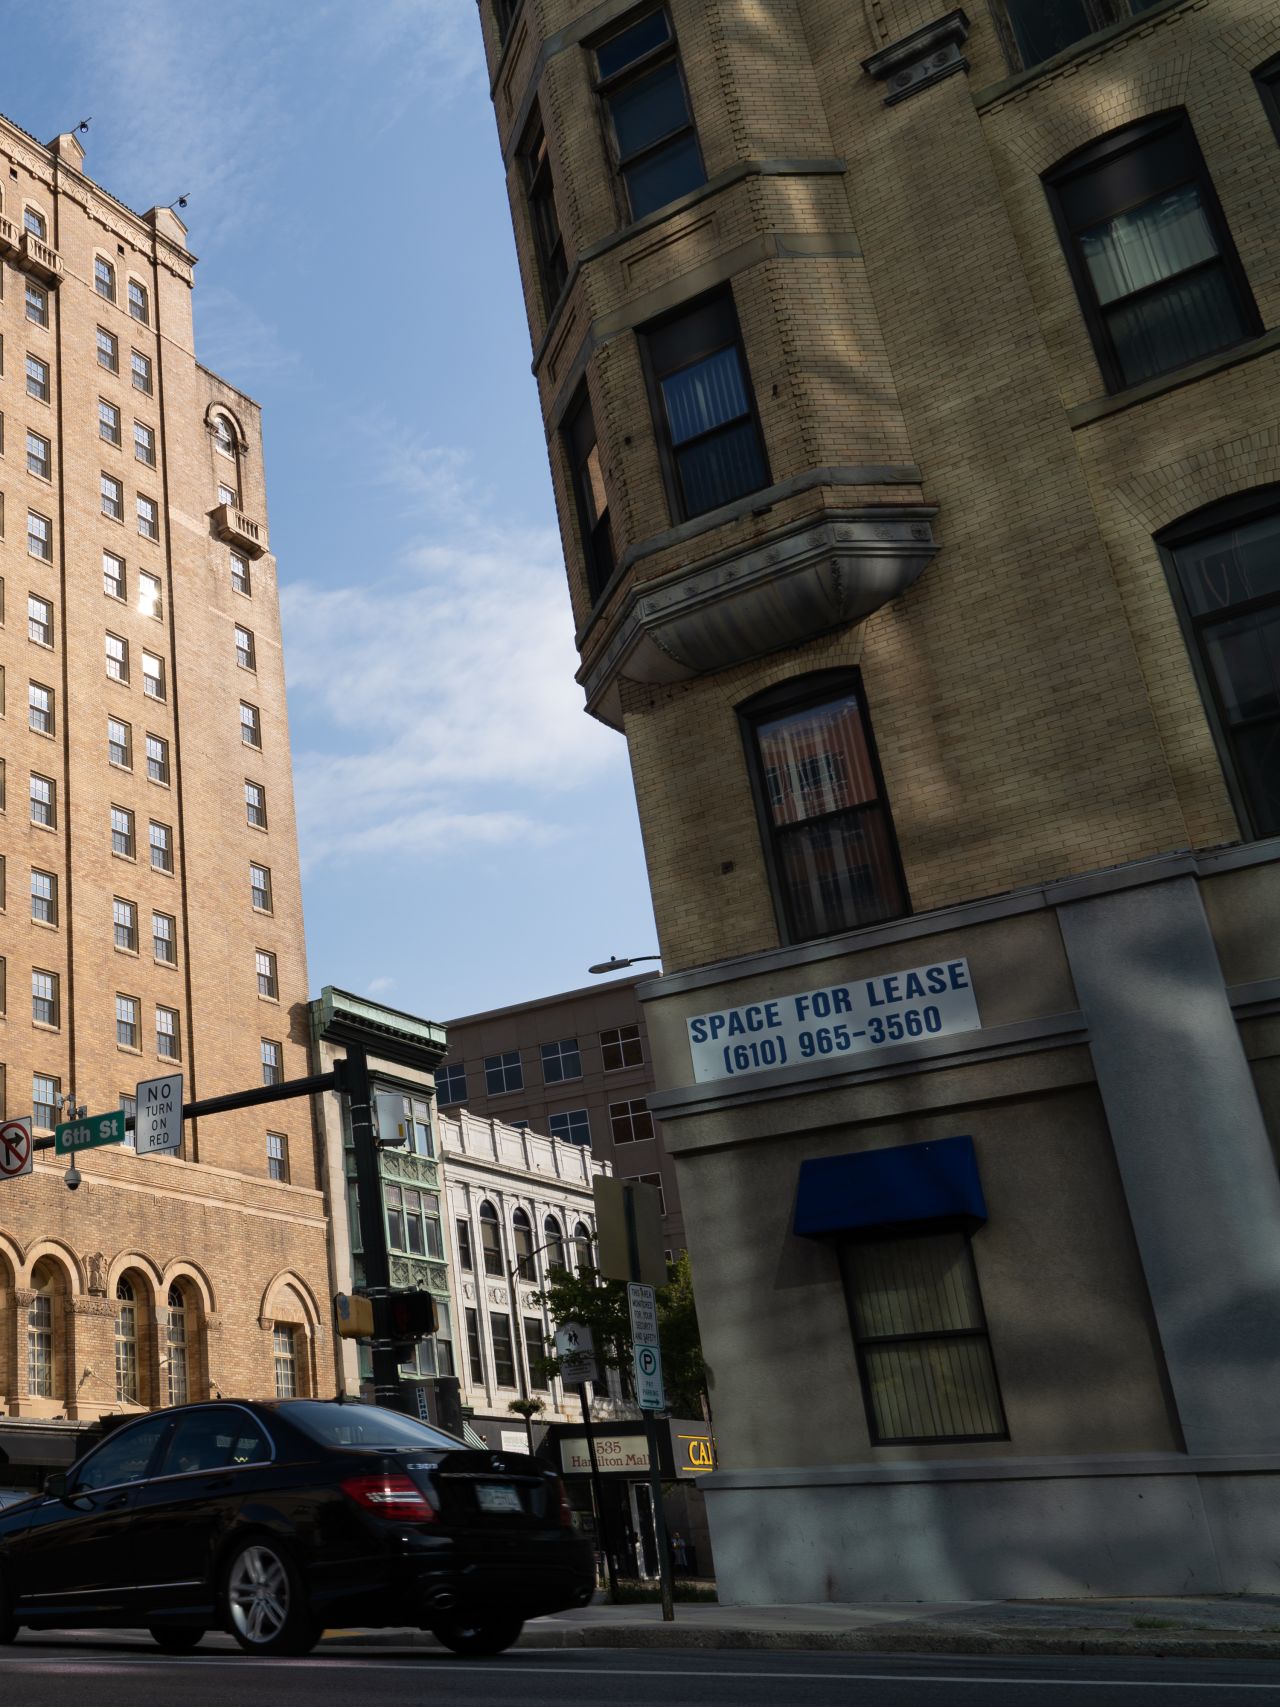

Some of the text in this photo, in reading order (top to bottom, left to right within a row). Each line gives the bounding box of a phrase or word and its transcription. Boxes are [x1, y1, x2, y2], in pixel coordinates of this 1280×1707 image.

[690, 962, 969, 1044] SPACE FOR LEASE
[723, 1005, 943, 1074] (610) 965-3560
[147, 1083, 171, 1102] NO
[146, 1101, 173, 1117] TURN
[151, 1117, 167, 1131] ON
[62, 1120, 118, 1147] 6th St
[149, 1132, 169, 1147] RED
[643, 1353, 653, 1371] P
[596, 1441, 622, 1455] 535
